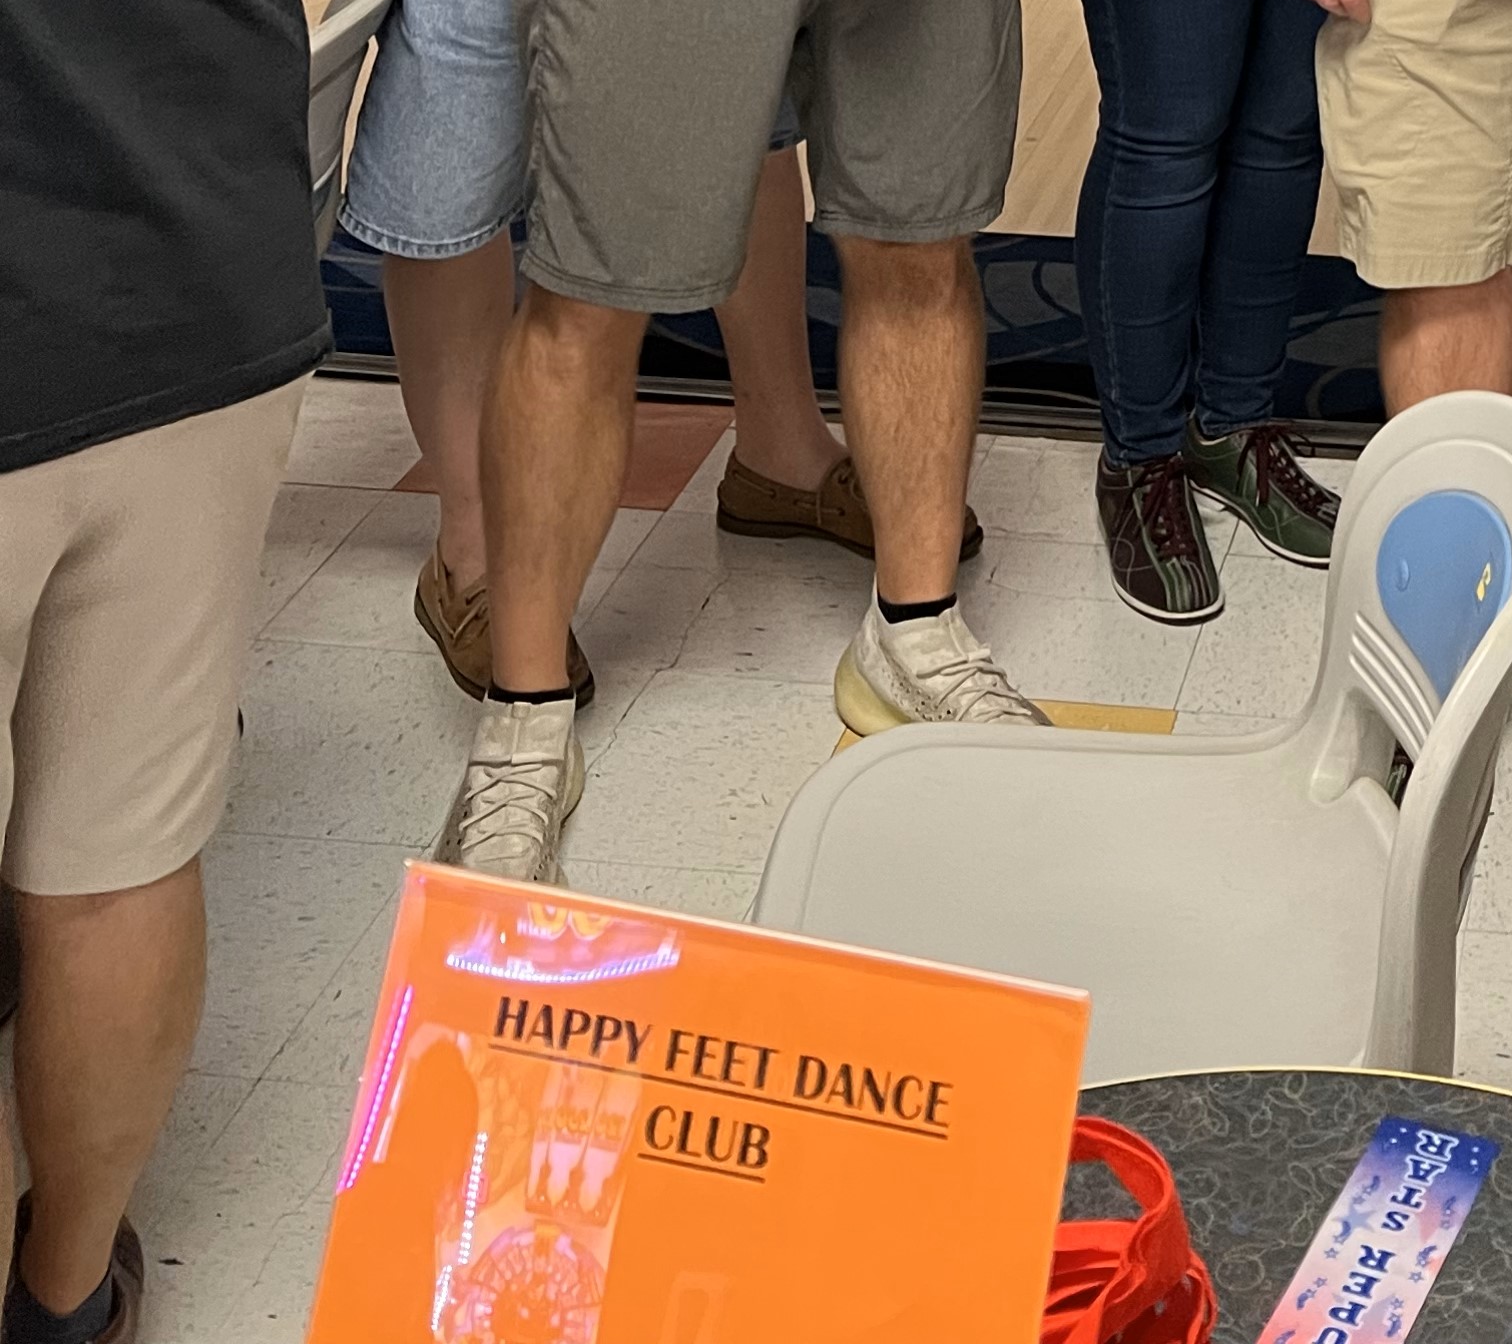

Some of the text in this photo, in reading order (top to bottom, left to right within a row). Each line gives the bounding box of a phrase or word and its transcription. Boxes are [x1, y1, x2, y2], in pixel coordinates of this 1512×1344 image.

[495, 997, 953, 1128] HAPPY FEET DANCE
[645, 1105, 771, 1171] CLUB
[1311, 1244, 1397, 1344] UPER
